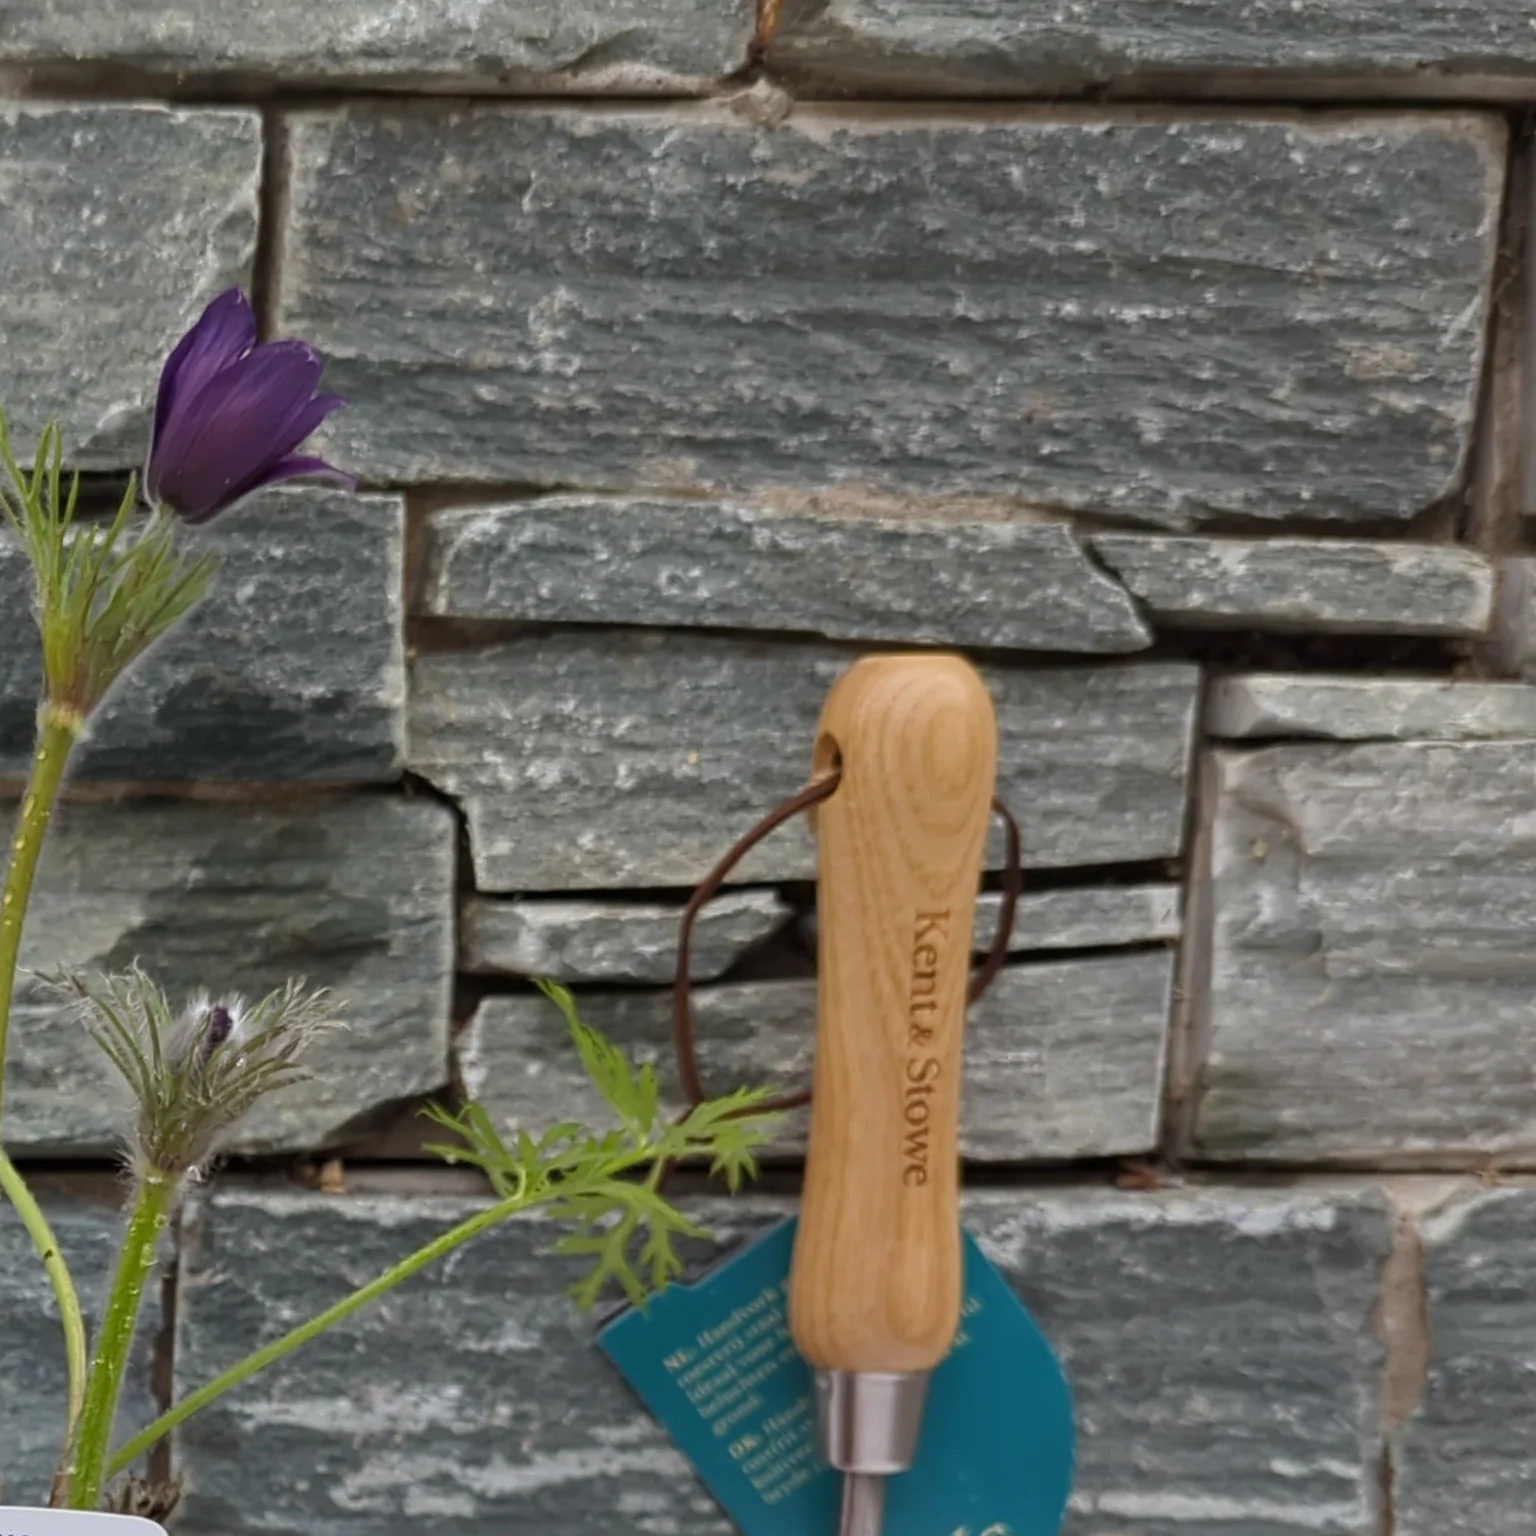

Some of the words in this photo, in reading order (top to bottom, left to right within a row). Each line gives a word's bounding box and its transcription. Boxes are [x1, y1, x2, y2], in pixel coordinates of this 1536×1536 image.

[910, 908, 951, 1017] Kent
[908, 1022, 935, 1048] &
[902, 1057, 941, 1188] Stowe
